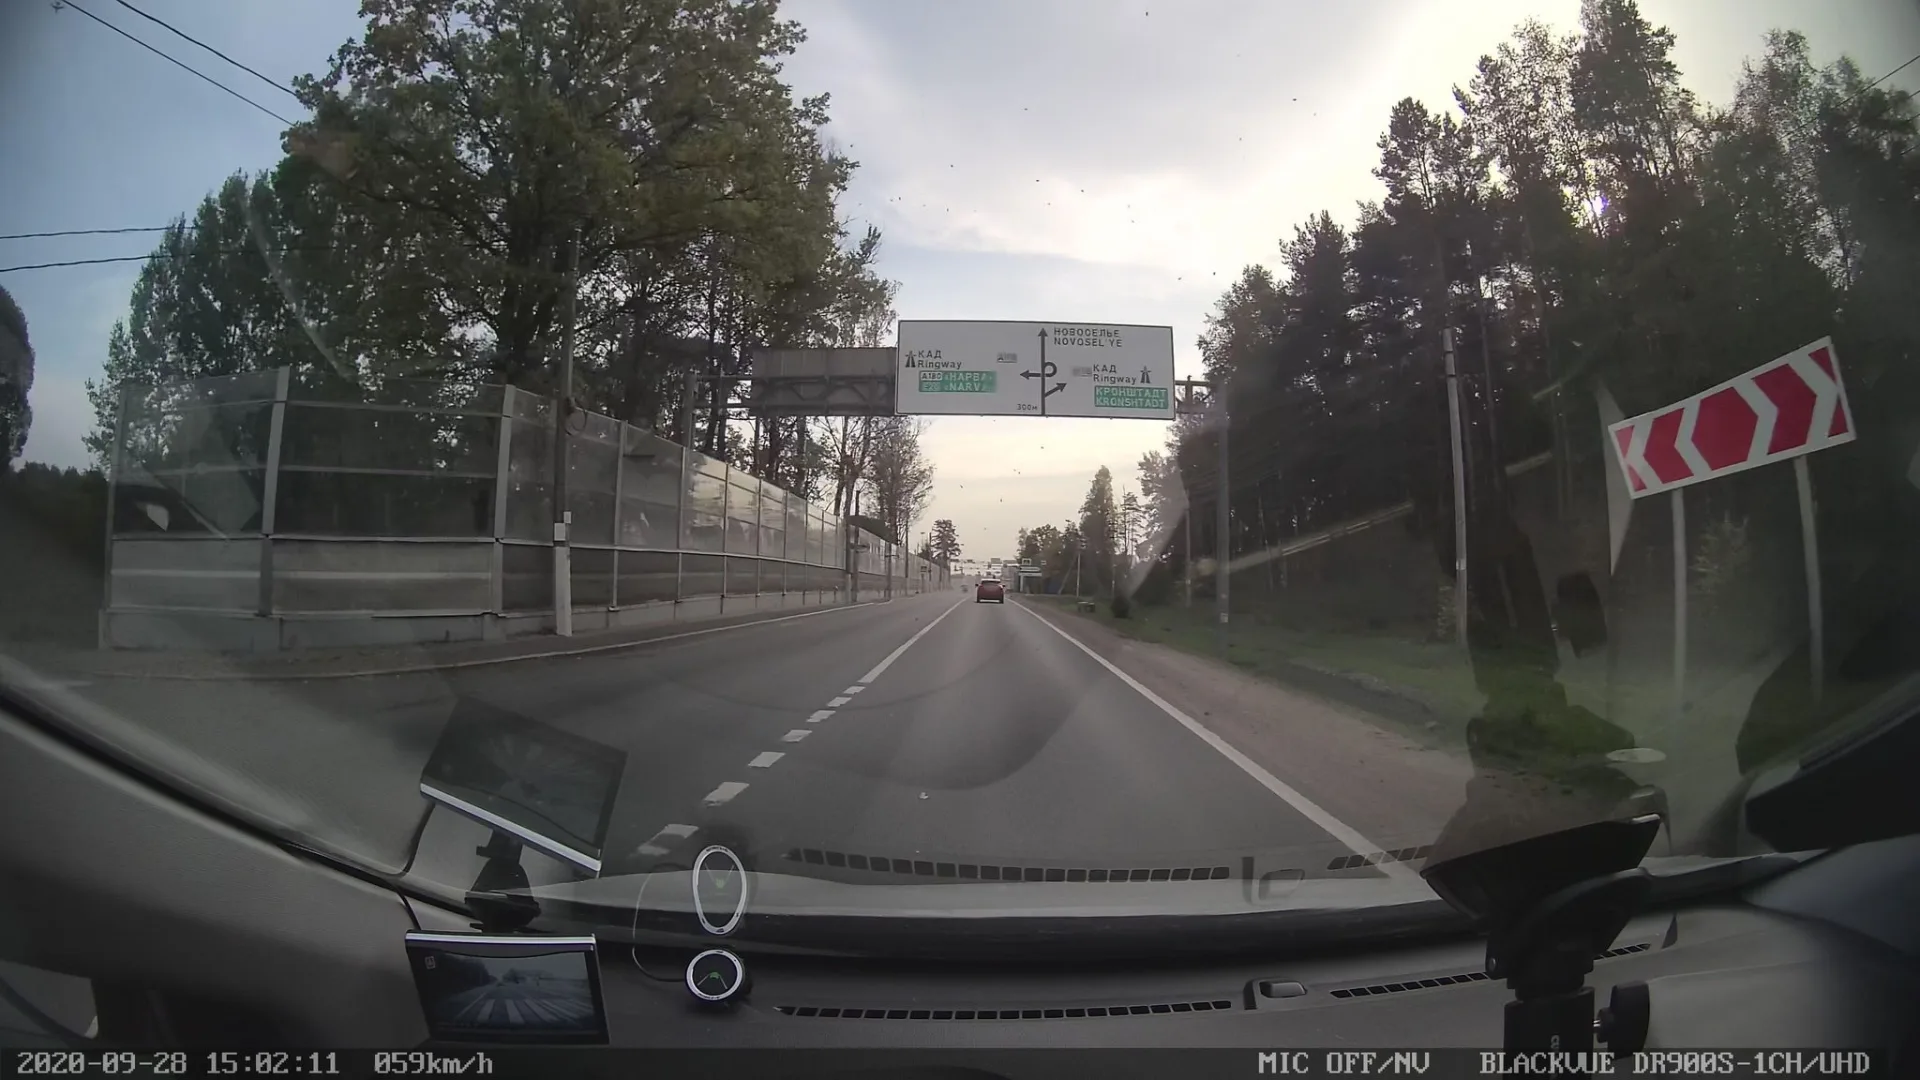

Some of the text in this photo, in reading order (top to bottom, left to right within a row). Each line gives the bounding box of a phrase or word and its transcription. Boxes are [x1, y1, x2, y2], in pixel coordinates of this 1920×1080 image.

[1054, 327, 1120, 338] НОВОСЕЛЬЕ
[918, 350, 942, 359] КАД
[918, 360, 962, 370] Ringway
[1093, 364, 1117, 374] КАД
[1093, 374, 1137, 385] Ringway
[1096, 387, 1167, 398] КРОНШТАДТ
[1096, 397, 1165, 408] KRONSHTADT
